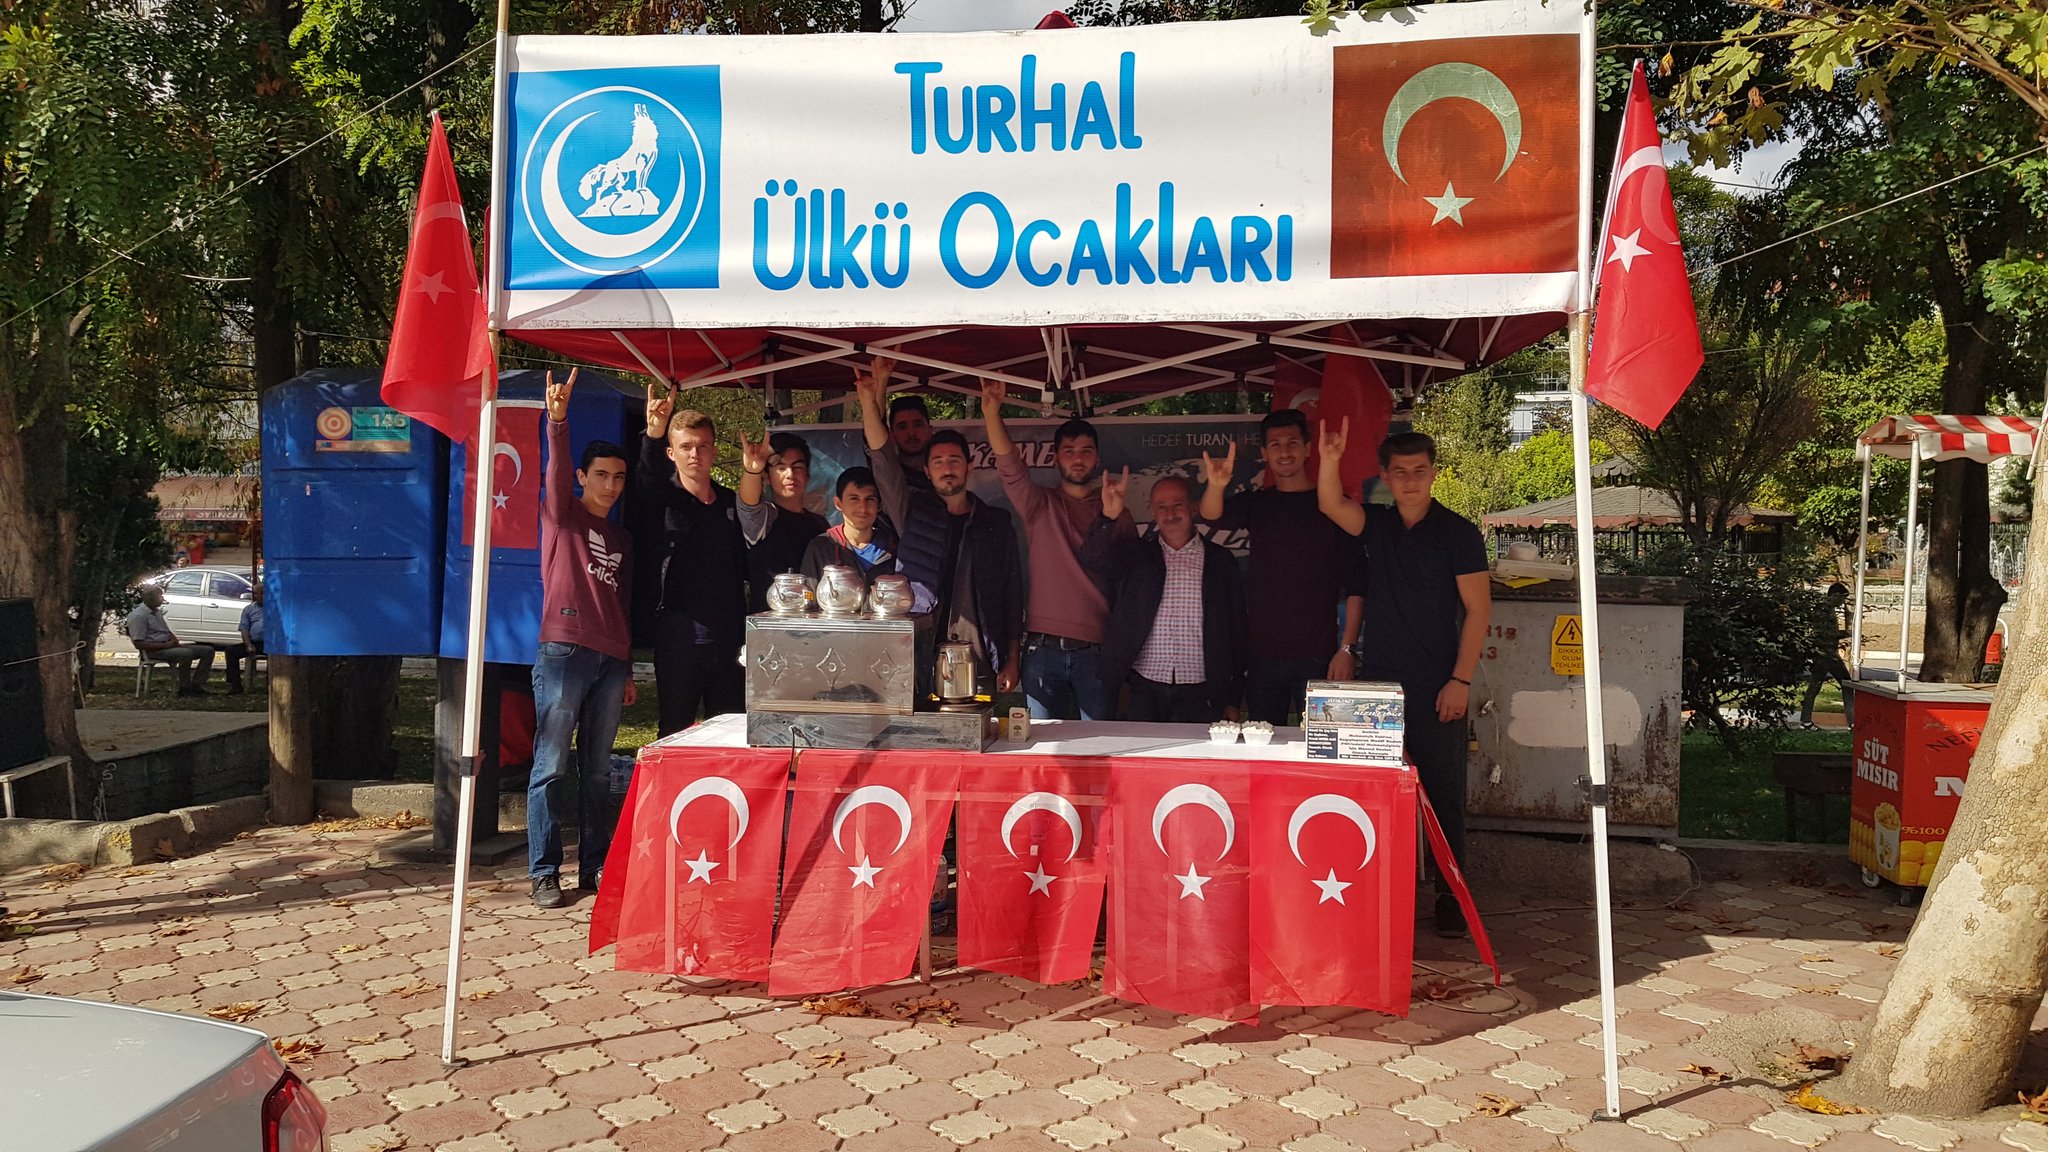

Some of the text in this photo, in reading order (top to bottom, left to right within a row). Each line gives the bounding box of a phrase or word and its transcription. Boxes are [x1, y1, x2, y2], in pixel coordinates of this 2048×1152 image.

[894, 51, 1143, 154] TURHAL
[752, 178, 1293, 291] ÜLKÜ OCAKLARI
[1141, 433, 1183, 447] HEDEF
[1186, 433, 1233, 446] TURAN
[1863, 736, 1889, 765] SÜT
[1856, 758, 1899, 792] MISIR
[1901, 826, 1945, 836] %100
